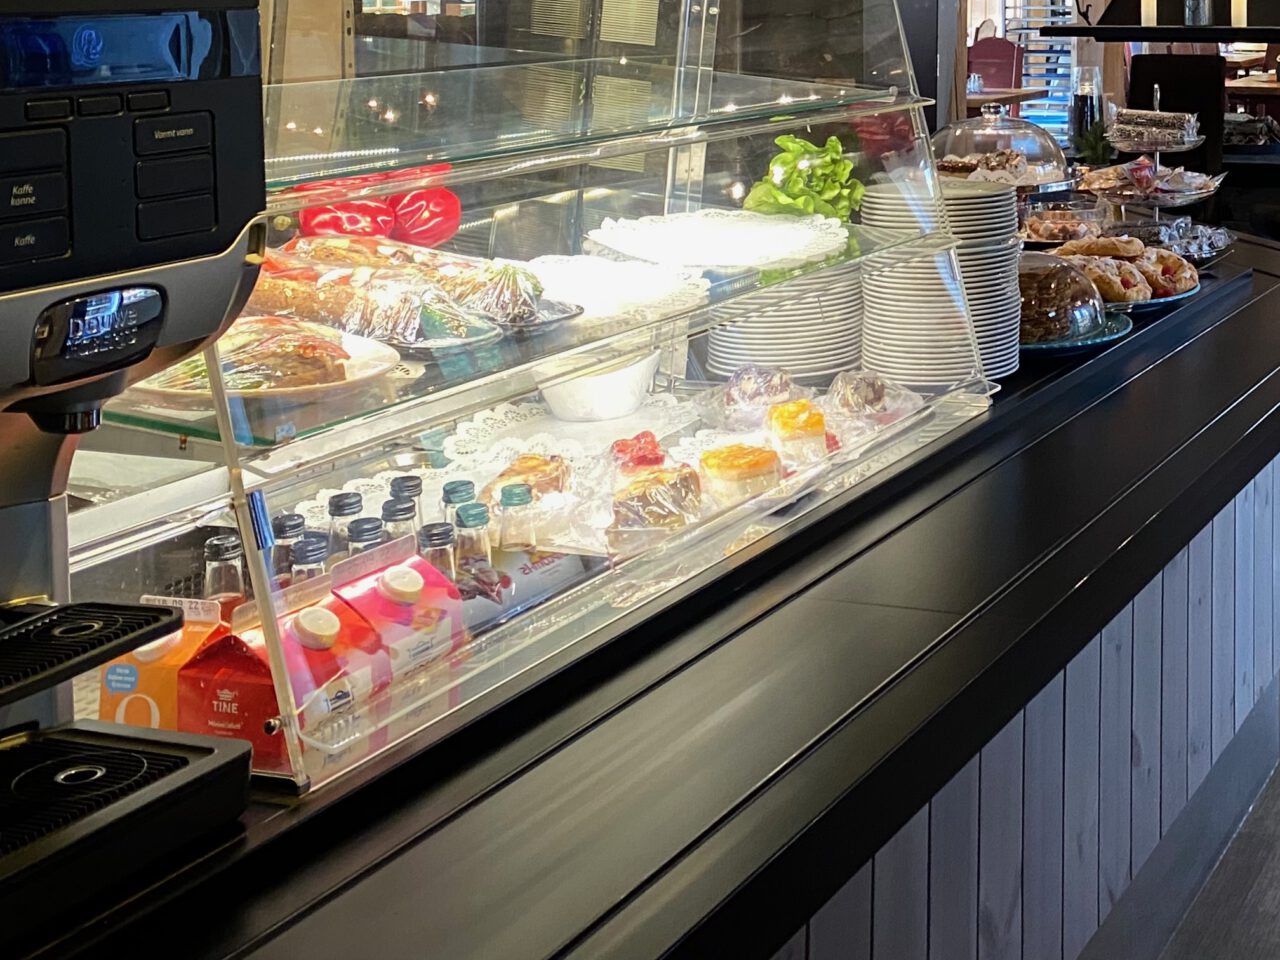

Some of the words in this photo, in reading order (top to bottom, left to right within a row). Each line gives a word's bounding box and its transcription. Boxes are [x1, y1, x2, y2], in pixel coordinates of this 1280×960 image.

[154, 129, 175, 139] Varmt
[176, 128, 194, 137] vann
[12, 184, 34, 195] Kaffe
[10, 195, 36, 206] kanne
[14, 234, 36, 247] Kaffe
[187, 600, 200, 611] 22
[212, 700, 239, 714] TINE
